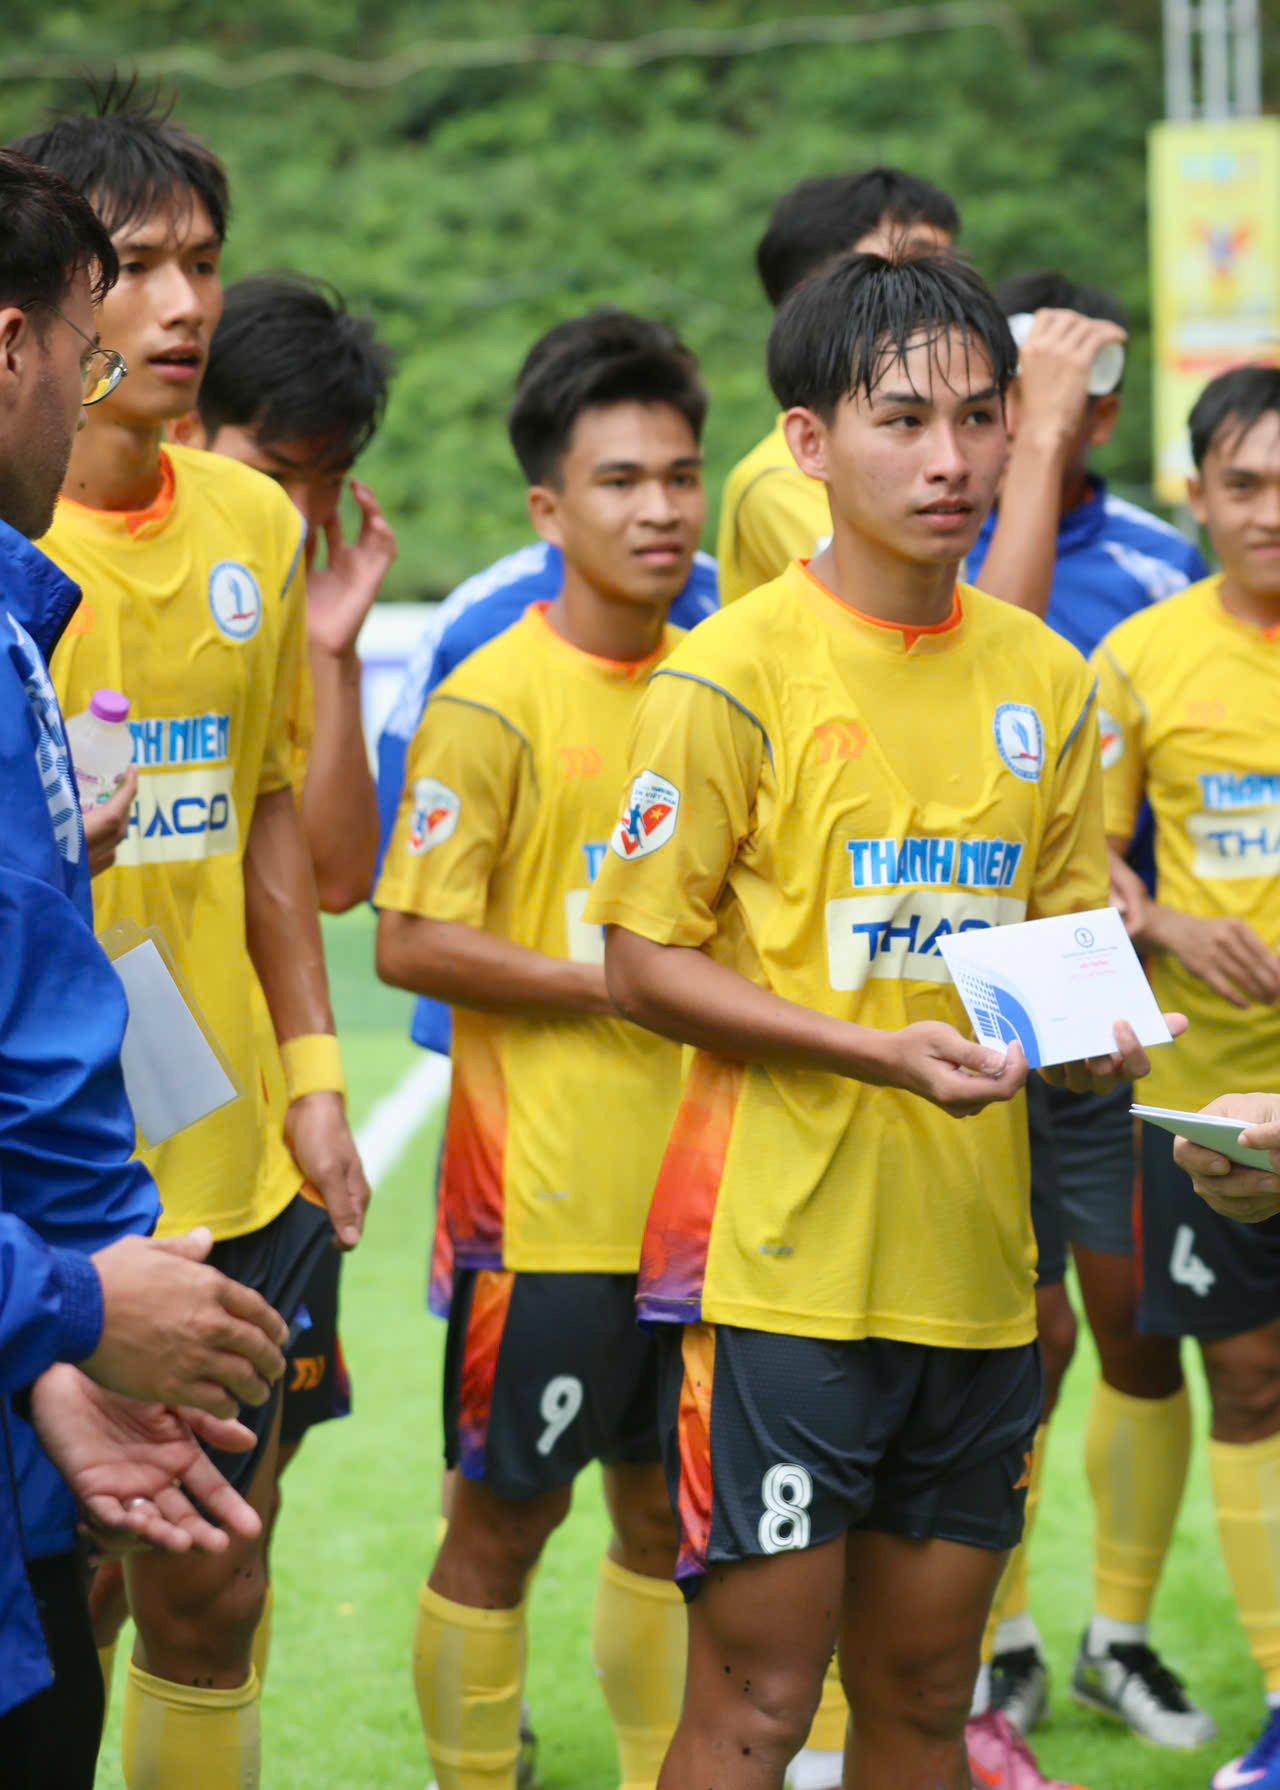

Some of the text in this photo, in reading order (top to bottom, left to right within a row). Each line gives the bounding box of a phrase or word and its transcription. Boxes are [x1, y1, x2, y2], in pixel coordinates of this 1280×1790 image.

[126, 793, 229, 840] HACO
[848, 836, 957, 889] THANH
[1169, 1223, 1217, 1297] 4
[536, 1374, 583, 1455] 9
[758, 1462, 814, 1556] 8
